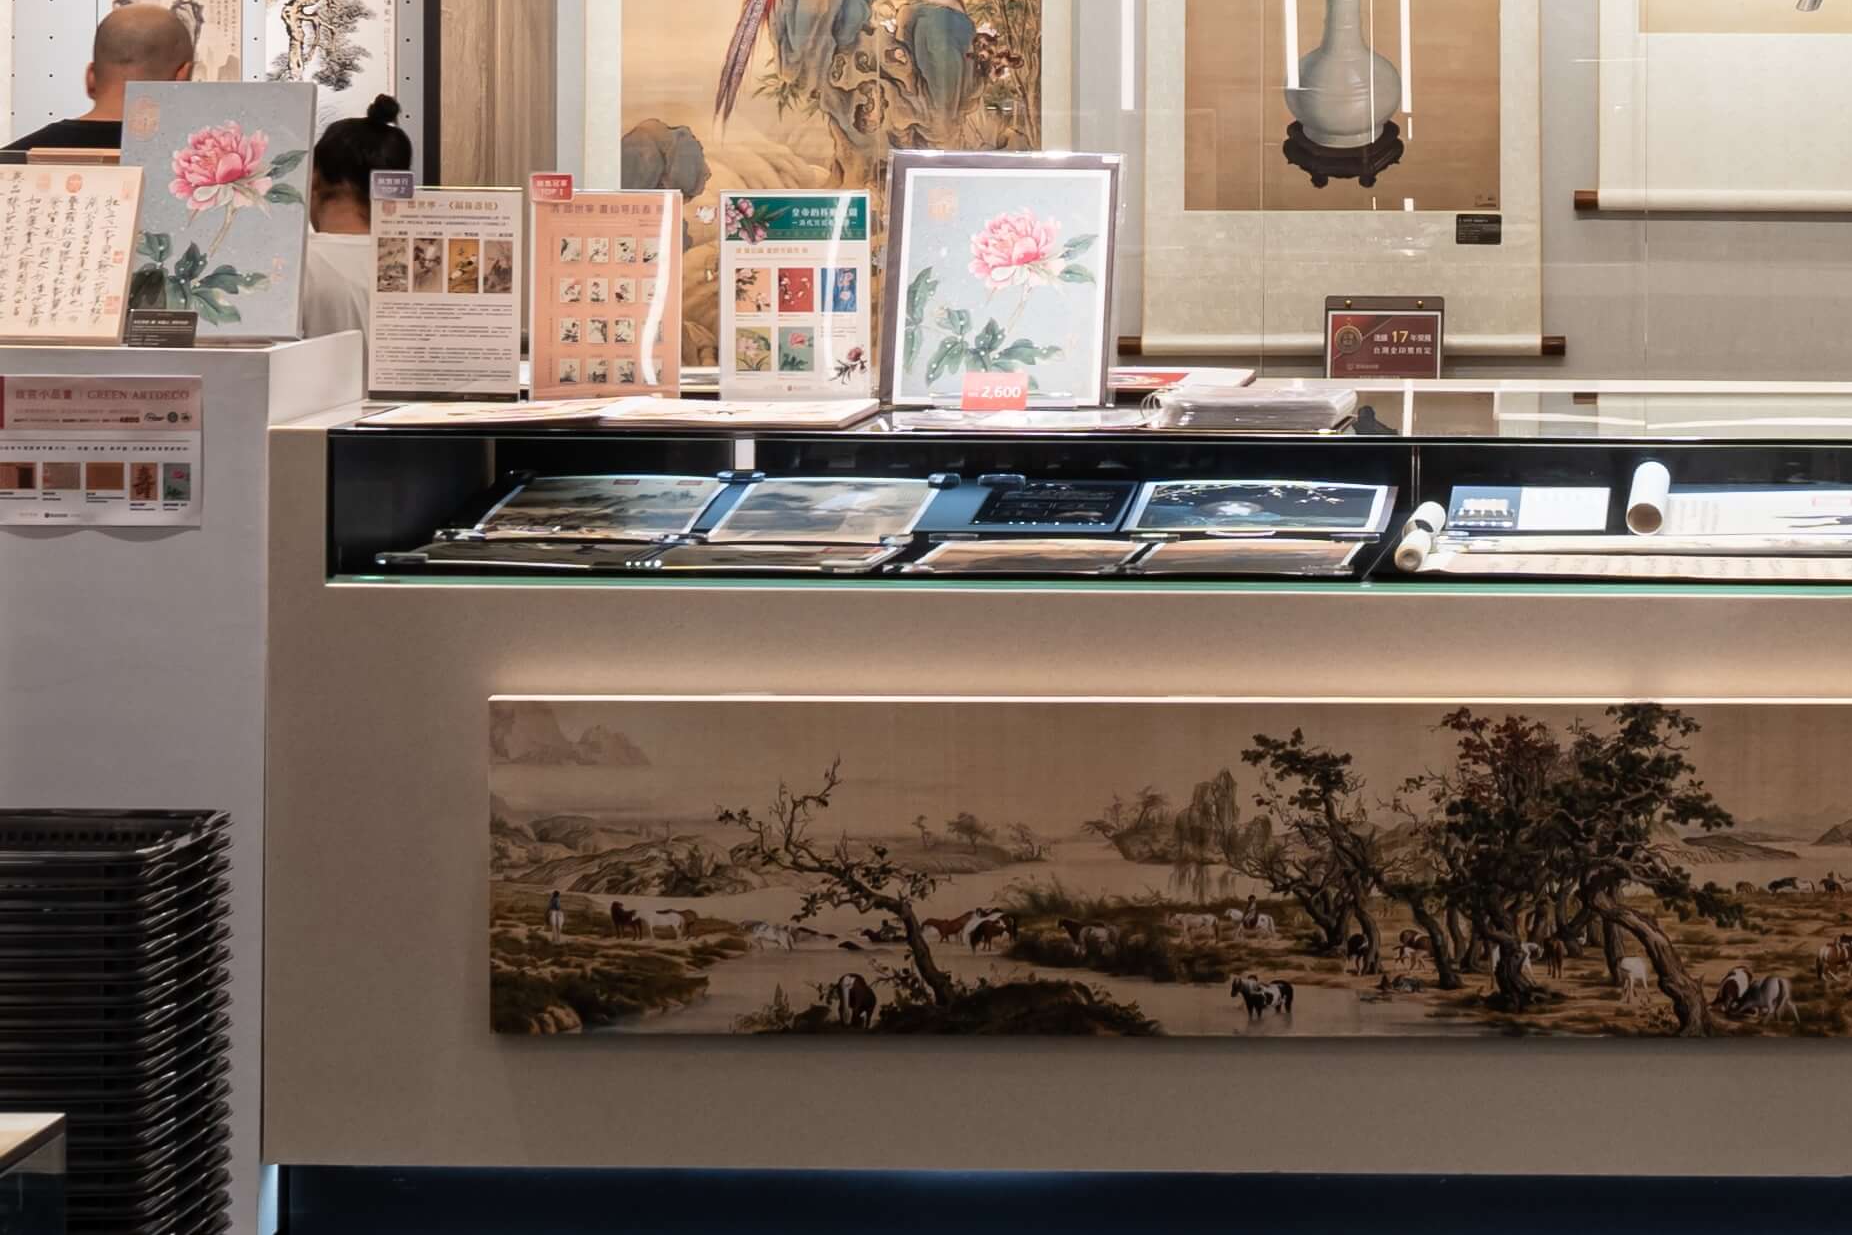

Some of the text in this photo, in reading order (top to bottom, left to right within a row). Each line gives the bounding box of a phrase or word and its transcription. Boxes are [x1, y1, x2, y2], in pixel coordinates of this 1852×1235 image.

[1391, 330, 1409, 344] 17
[87, 389, 128, 400] GREEN
[981, 386, 1022, 400] 2,600
